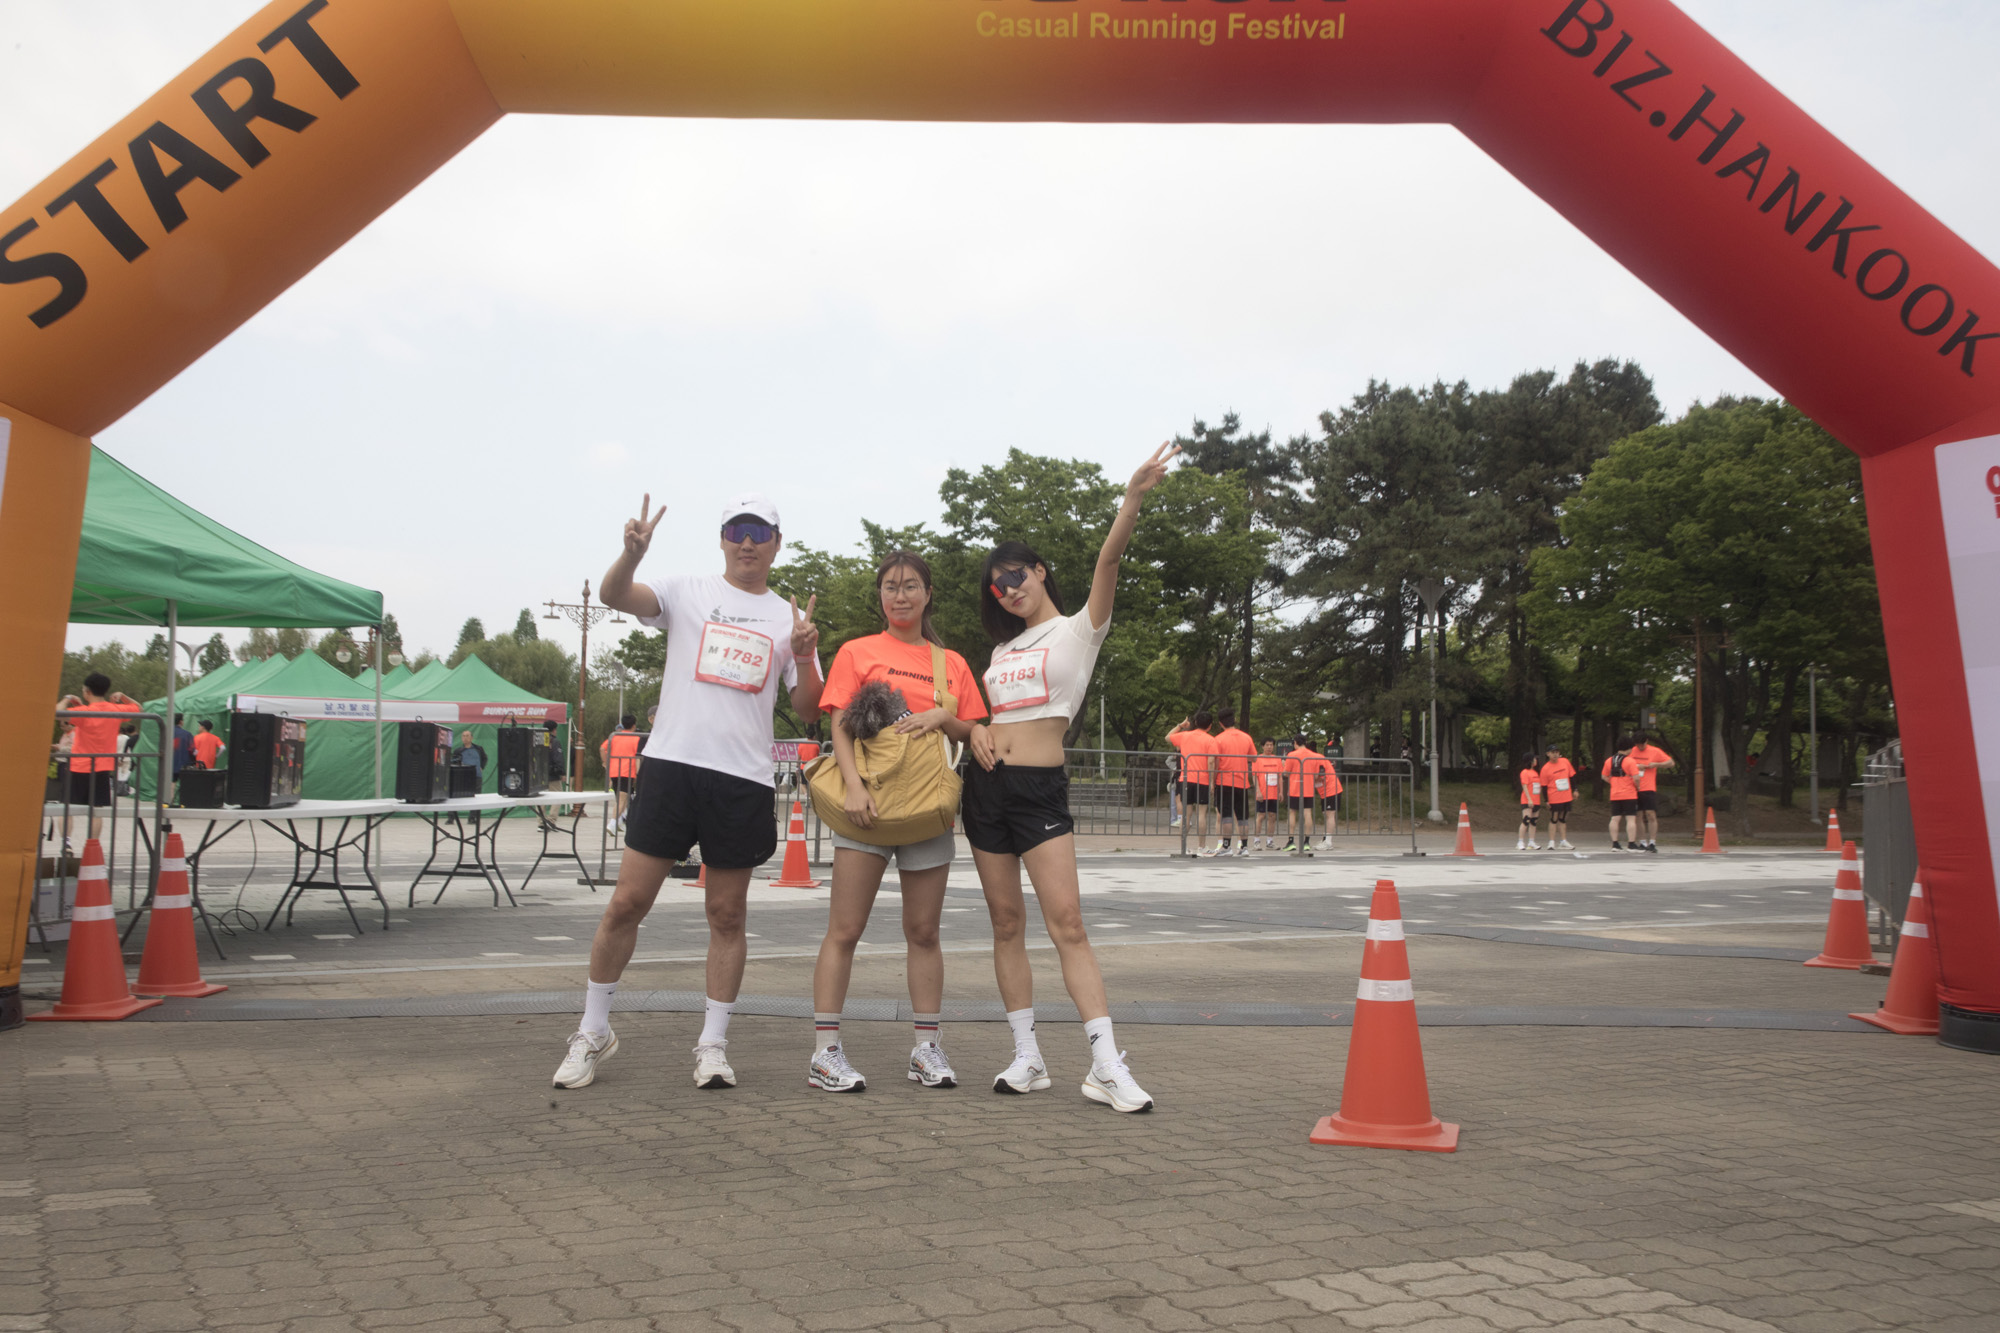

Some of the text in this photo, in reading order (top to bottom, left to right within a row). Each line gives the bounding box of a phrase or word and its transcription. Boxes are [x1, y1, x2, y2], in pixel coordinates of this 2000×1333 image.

[975, 10, 1346, 45] Casual Running Festival
[0, 0, 361, 329] START
[1540, 0, 2000, 377] BIZ.HANKOOK
[708, 645, 719, 654] M
[722, 646, 763, 667] 1782
[719, 668, 741, 681] C-340
[887, 667, 933, 683] BURNING
[989, 667, 1036, 685] W 3183
[482, 706, 548, 716] BURNING RUN
